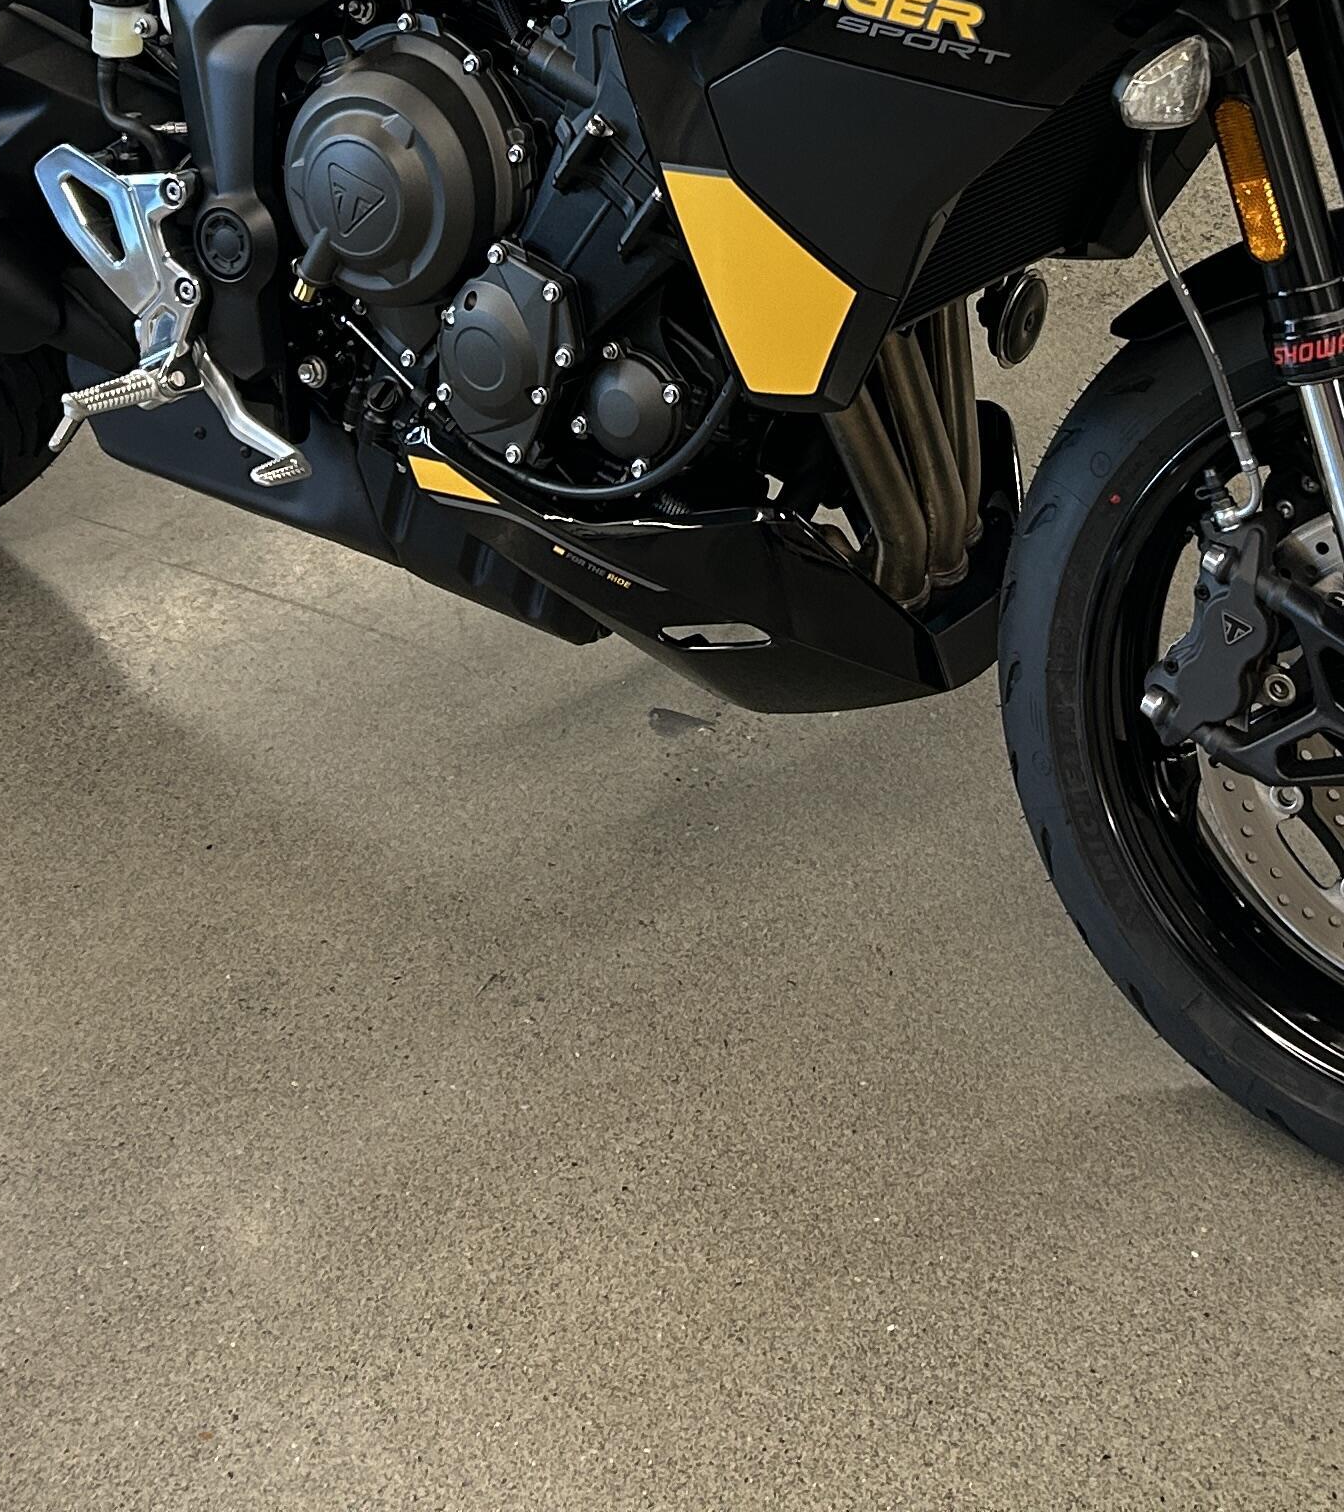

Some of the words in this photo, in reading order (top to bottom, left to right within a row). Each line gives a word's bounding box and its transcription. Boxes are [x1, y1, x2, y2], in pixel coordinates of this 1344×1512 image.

[835, 15, 1011, 65] SPORT
[566, 552, 586, 567] FOR
[586, 562, 606, 577] THE
[606, 573, 632, 589] RIDE
